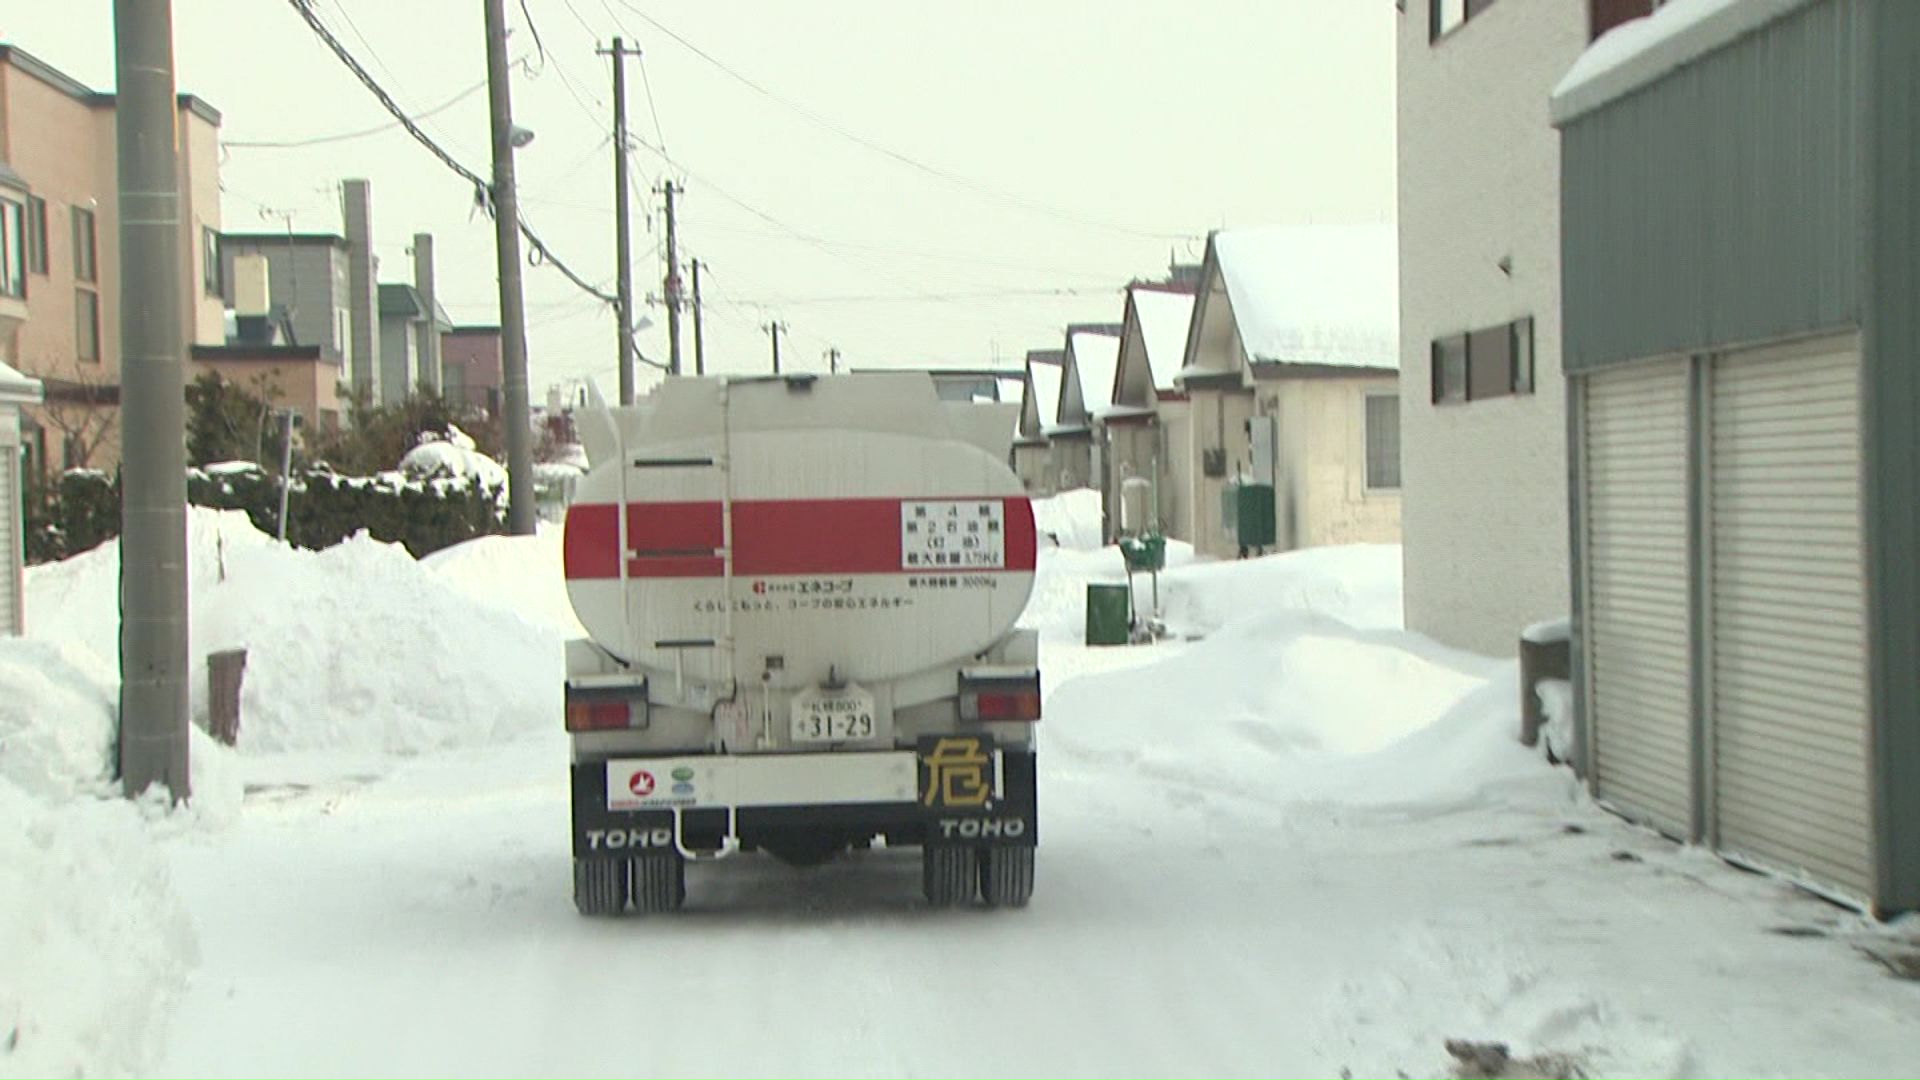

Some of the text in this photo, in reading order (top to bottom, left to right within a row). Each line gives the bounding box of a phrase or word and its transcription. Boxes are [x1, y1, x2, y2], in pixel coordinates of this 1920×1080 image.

[810, 714, 872, 737] 31-29
[923, 737, 990, 808] 危
[586, 828, 672, 849] TOHO
[939, 817, 1025, 838] TOHO
